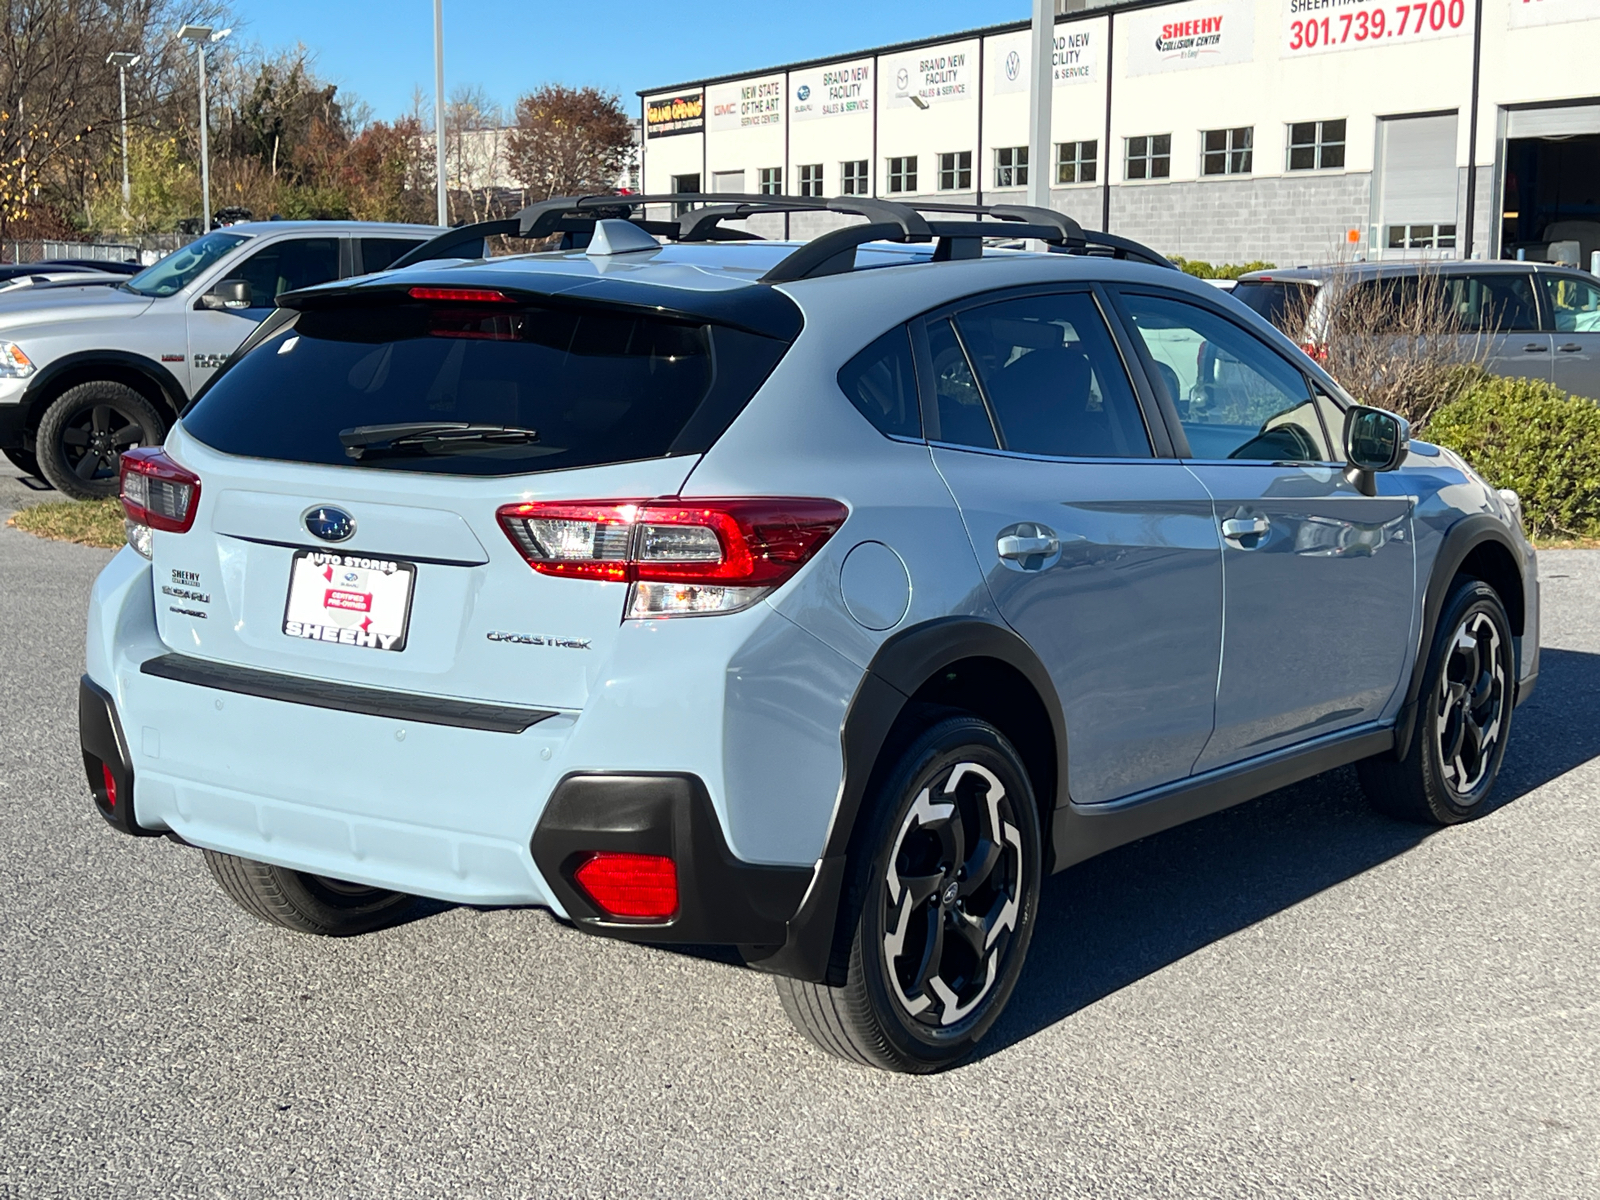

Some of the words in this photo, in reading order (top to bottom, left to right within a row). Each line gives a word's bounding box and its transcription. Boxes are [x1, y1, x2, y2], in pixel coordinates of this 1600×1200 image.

[1162, 15, 1223, 39] SHEEHY
[1289, 0, 1465, 50] 301.739.7700
[1068, 32, 1090, 48] NEW
[1162, 38, 1195, 52] COLLISION
[1196, 34, 1221, 47] CENTER
[919, 57, 946, 72] BRAND
[948, 54, 965, 67] NEW
[1052, 49, 1081, 66] CILITY
[823, 70, 850, 86] BRAND
[851, 66, 869, 82] NEW
[925, 70, 958, 86] FACILITY
[1055, 70, 1060, 80] &
[1061, 66, 1089, 79] SERVICE
[741, 86, 756, 100] NEW
[758, 82, 780, 97] STATE
[829, 83, 862, 100] FACILITY
[919, 88, 935, 98] SALES
[936, 87, 941, 96] &
[942, 84, 965, 95] SERVICE
[648, 105, 672, 123] GRAND
[672, 100, 702, 120] OPENING
[714, 103, 736, 116] GMC
[741, 102, 750, 115] OF
[751, 100, 764, 113] THE
[765, 97, 780, 111] ART
[822, 104, 839, 115] SALES
[840, 103, 845, 112] &
[846, 100, 869, 112] SERVICE
[741, 116, 760, 127] SERVICE
[761, 113, 780, 124] CENTER
[306, 552, 342, 566] AUTO
[344, 556, 398, 573] STORES
[172, 569, 200, 581] SHEEHY
[162, 586, 210, 603] SUBARU
[331, 592, 365, 603] CERTIFIED
[327, 597, 367, 610] PRE-OWNED
[285, 621, 397, 650] SHEEHY
[486, 631, 592, 650] CROSSTREK
